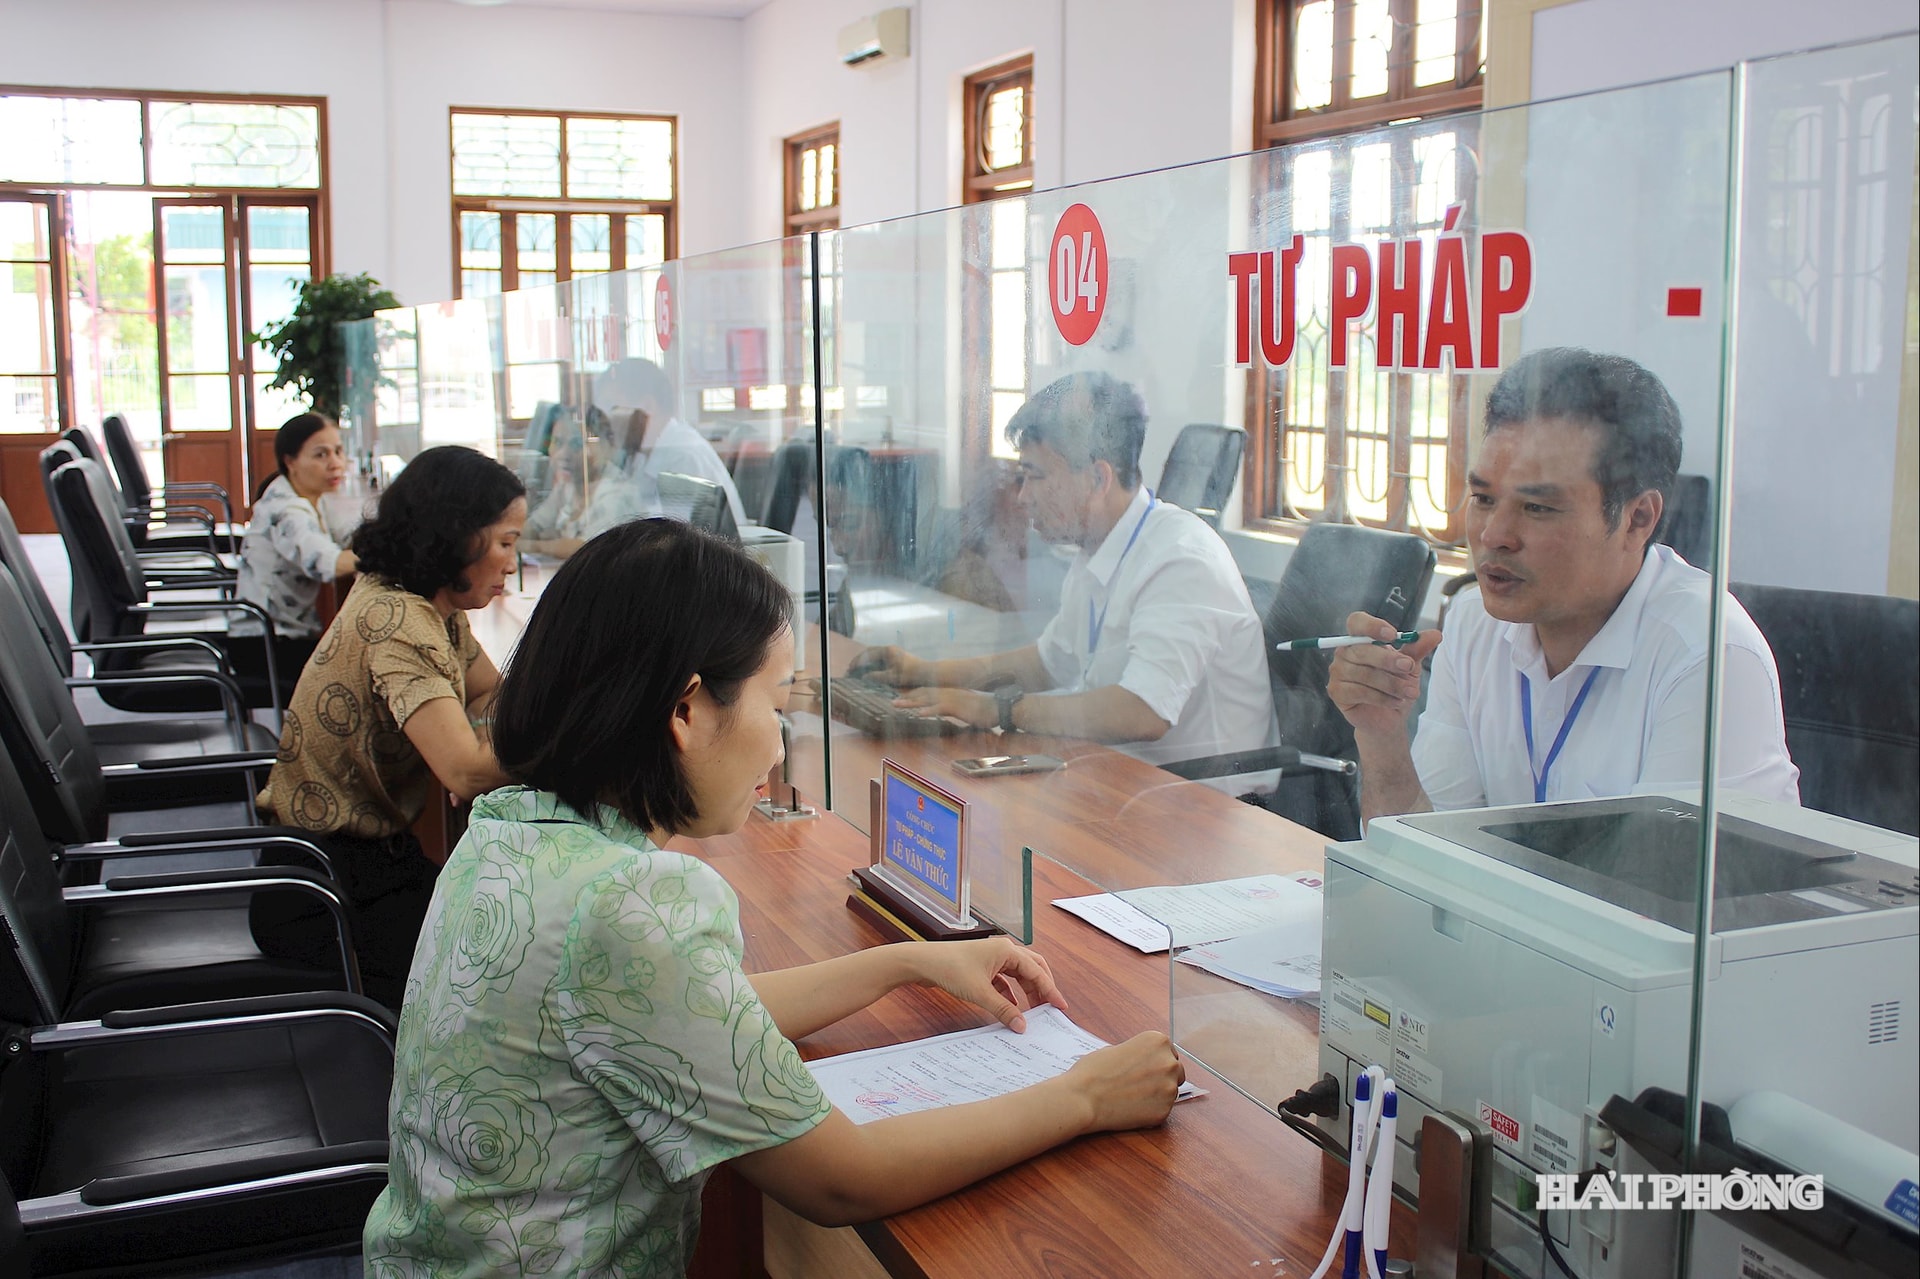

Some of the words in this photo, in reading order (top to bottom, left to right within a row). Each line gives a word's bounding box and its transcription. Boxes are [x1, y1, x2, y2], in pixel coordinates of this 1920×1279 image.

[1056, 230, 1100, 315] 04
[1227, 233, 1305, 369] TƯ
[1328, 200, 1537, 374] PHÁP
[656, 290, 670, 336] 05
[893, 839, 903, 860] LÊ
[905, 847, 923, 873] VĂN
[925, 861, 949, 890] THỨC
[1408, 1016, 1427, 1036] NTC
[1492, 1111, 1518, 1133] SAFETY
